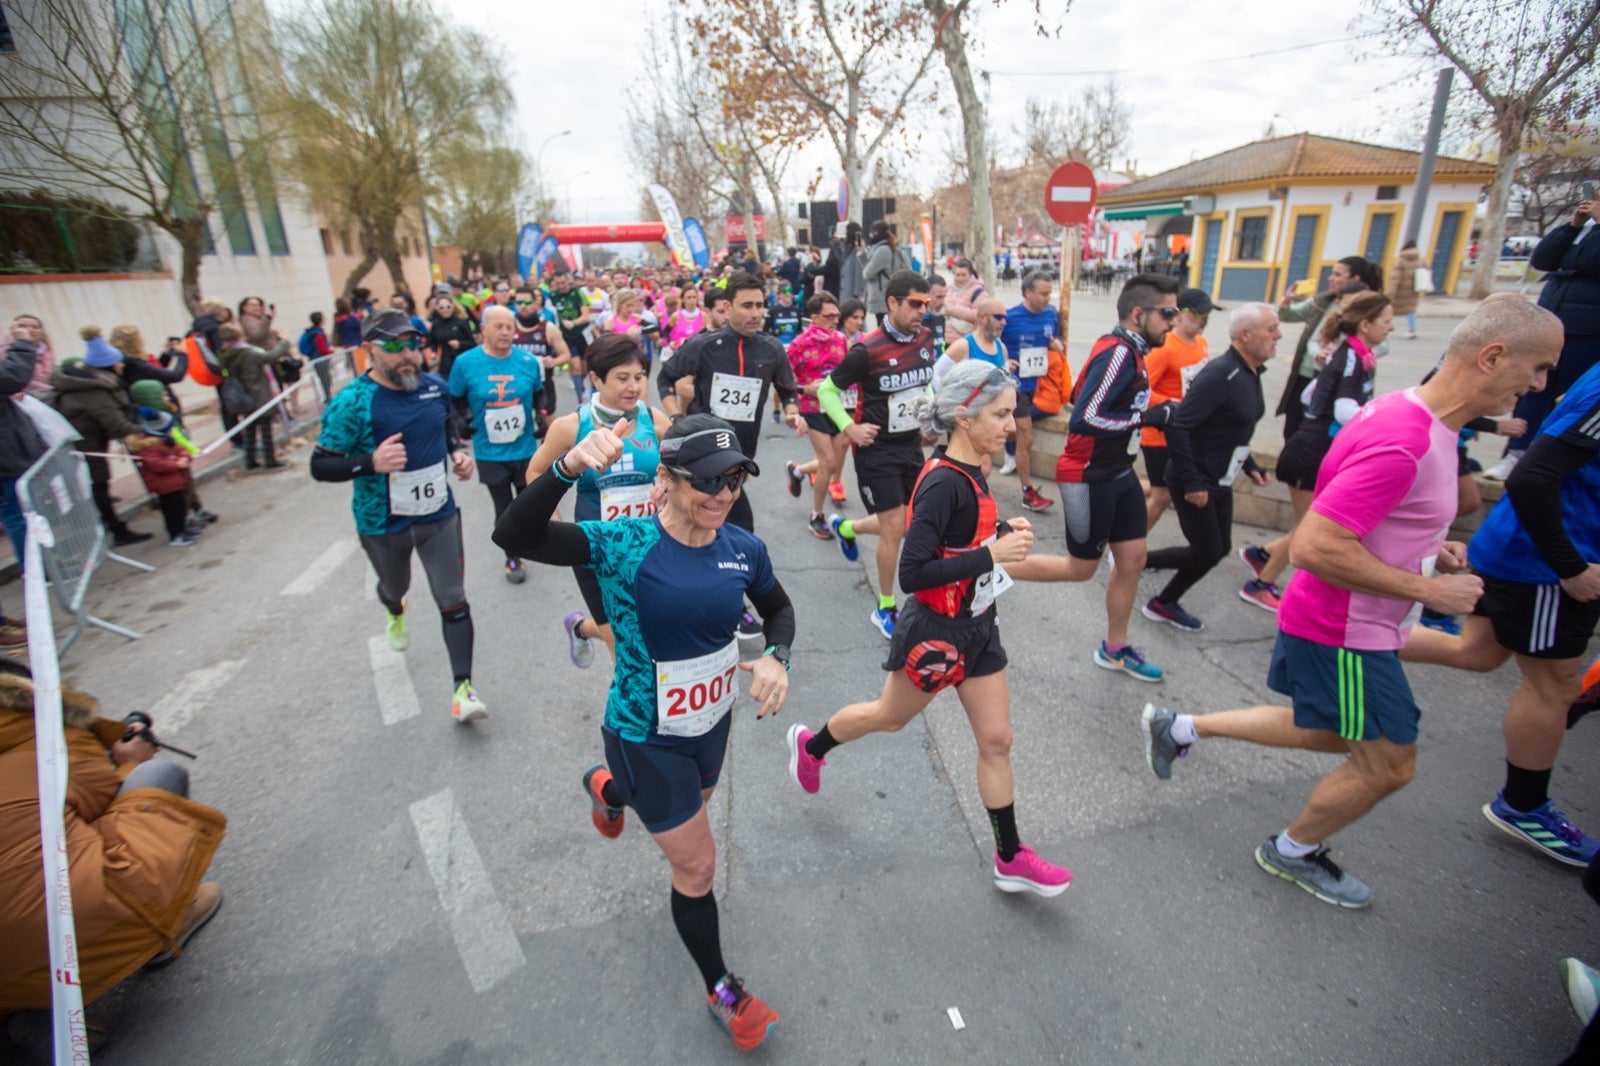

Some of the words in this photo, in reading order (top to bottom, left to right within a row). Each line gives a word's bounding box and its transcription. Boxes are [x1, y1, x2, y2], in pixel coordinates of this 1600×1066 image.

[1027, 356, 1044, 367] 172
[719, 388, 751, 407] 234
[493, 416, 520, 432] 412
[410, 482, 435, 501] 16
[665, 665, 737, 717] 2007
